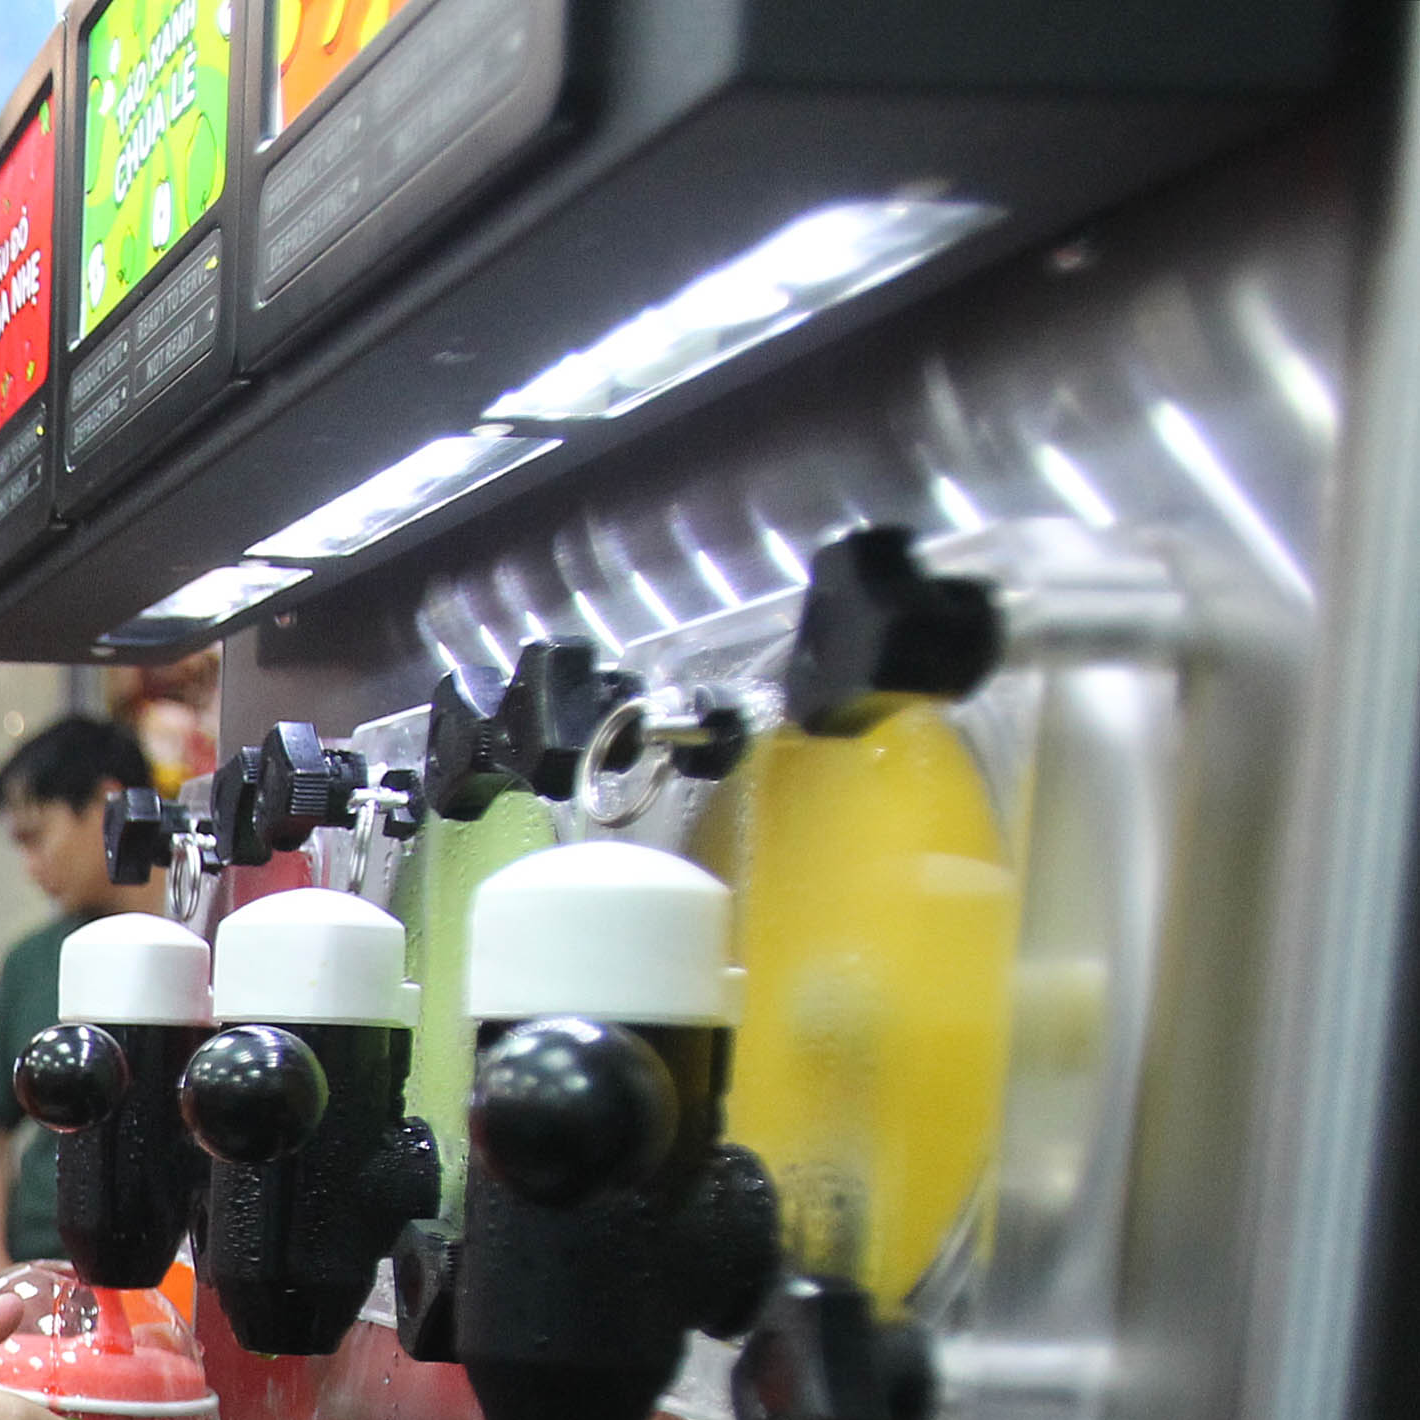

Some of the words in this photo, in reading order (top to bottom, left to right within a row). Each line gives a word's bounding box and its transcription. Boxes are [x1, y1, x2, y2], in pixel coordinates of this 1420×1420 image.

[150, 0, 196, 83] XANH
[115, 91, 166, 204] CHUA
[11, 250, 41, 317] NHẸ
[145, 352, 165, 383] NOT
[165, 318, 197, 365] READY
